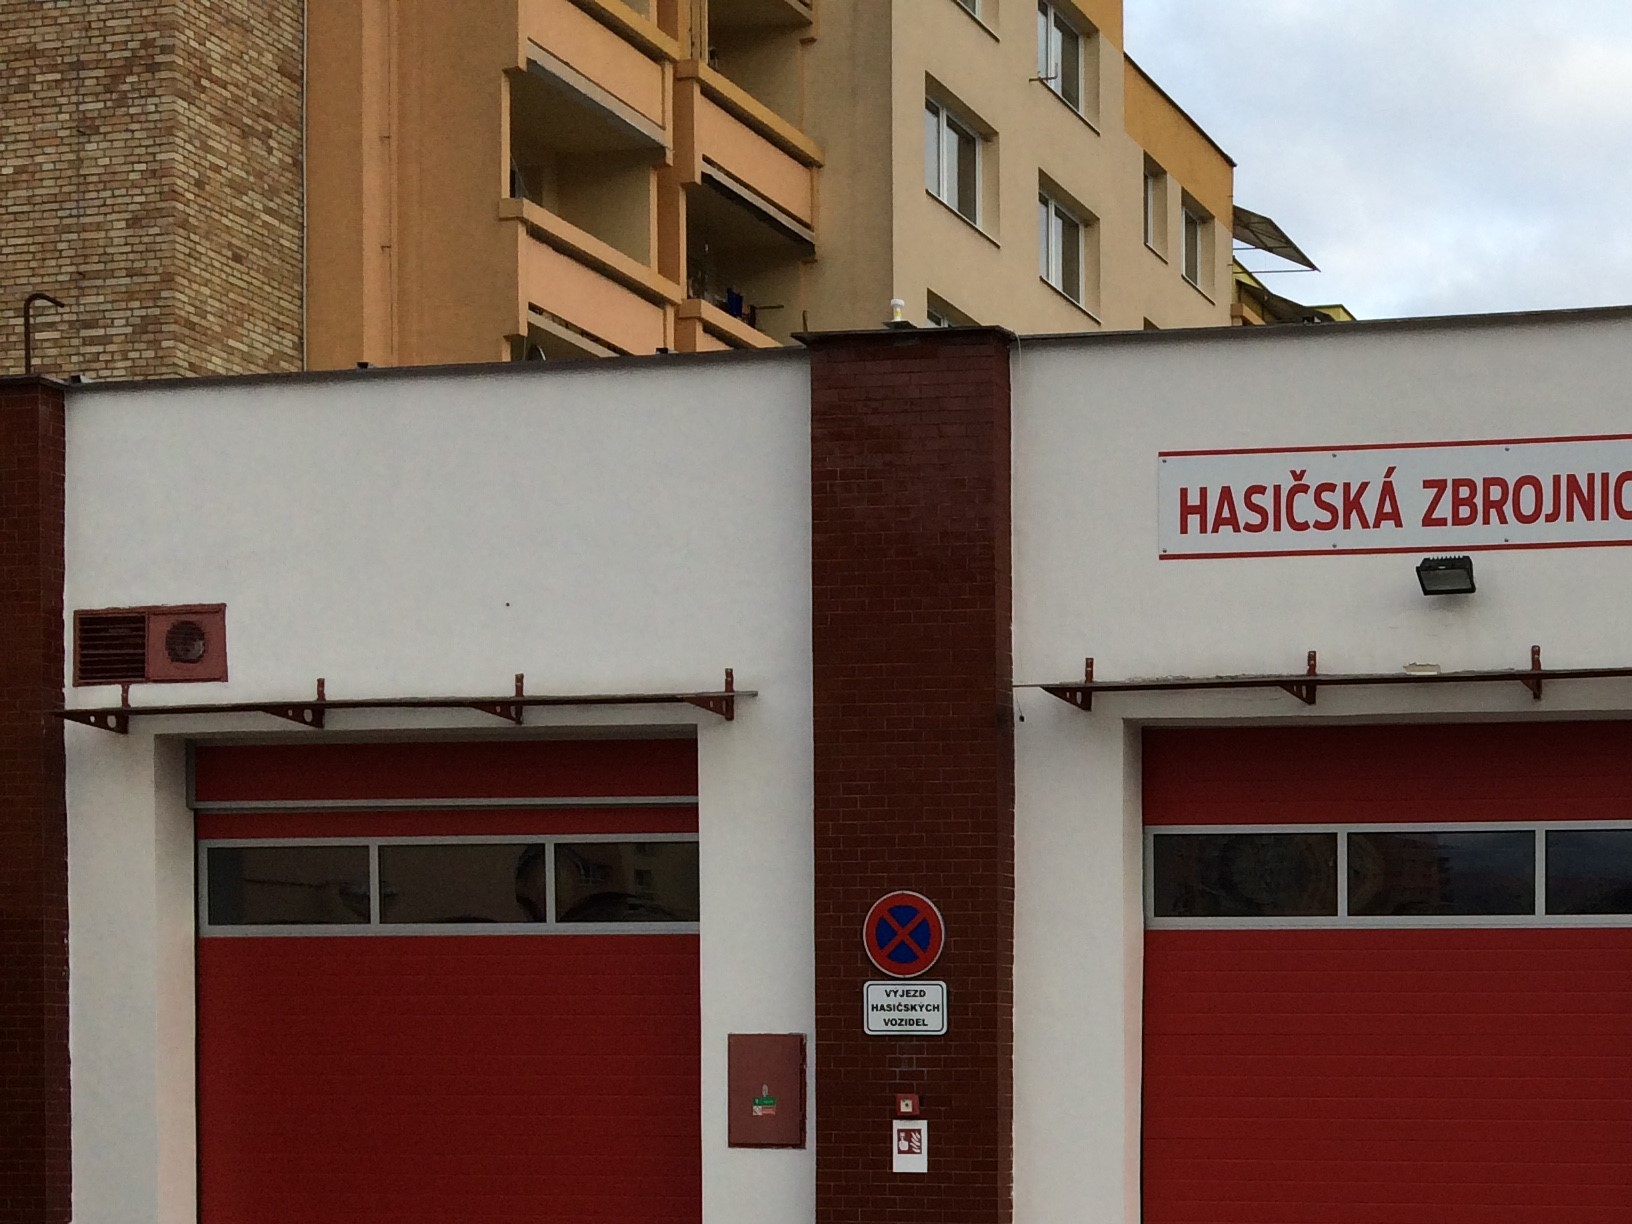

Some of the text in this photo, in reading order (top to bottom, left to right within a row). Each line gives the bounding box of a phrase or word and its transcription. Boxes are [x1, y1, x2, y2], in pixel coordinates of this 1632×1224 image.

[1179, 465, 1404, 535] HASIČSKÁ
[884, 987, 927, 998] VÝJEZD
[871, 1002, 940, 1013] HASIČSKÝCH
[882, 1018, 929, 1028] VOZIDEL
